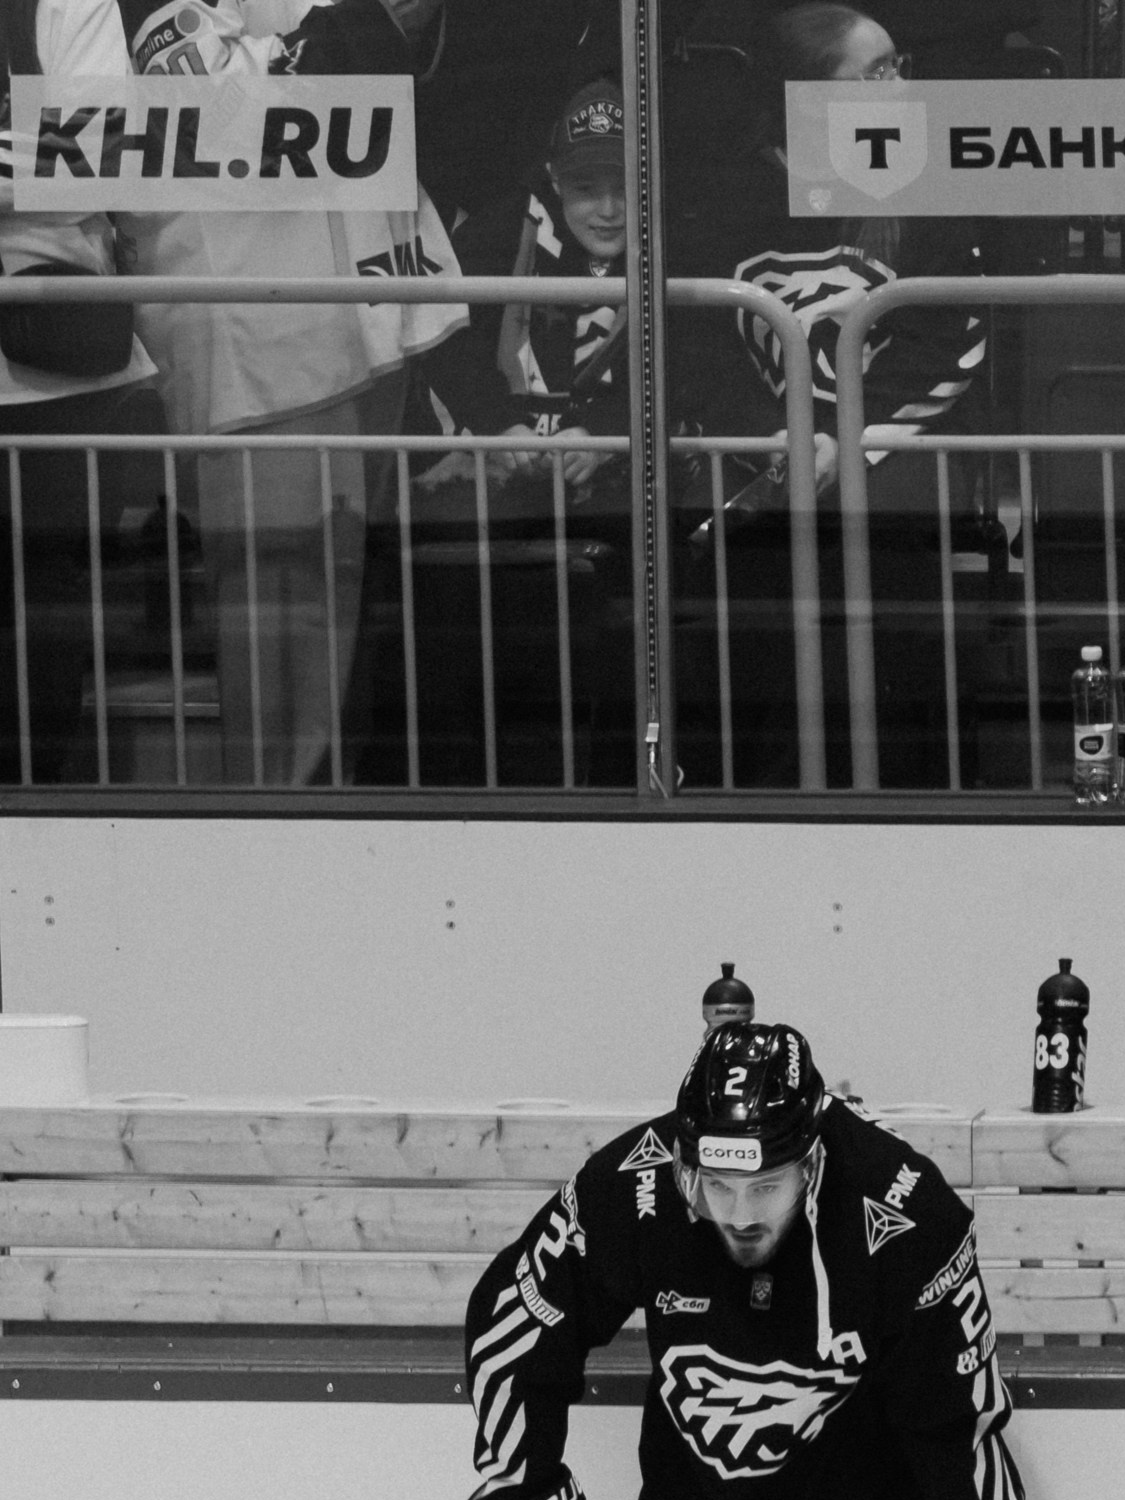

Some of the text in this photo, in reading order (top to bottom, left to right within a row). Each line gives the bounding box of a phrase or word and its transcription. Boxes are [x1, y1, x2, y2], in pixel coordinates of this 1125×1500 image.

[34, 107, 394, 178] KHL.RU
[571, 102, 623, 125] TRAKTO
[724, 1066, 748, 1096] 2
[1035, 1032, 1070, 1070] 83
[533, 1210, 568, 1282] 2
[919, 1238, 974, 1305] WINLINE
[952, 1276, 989, 1344] 2
